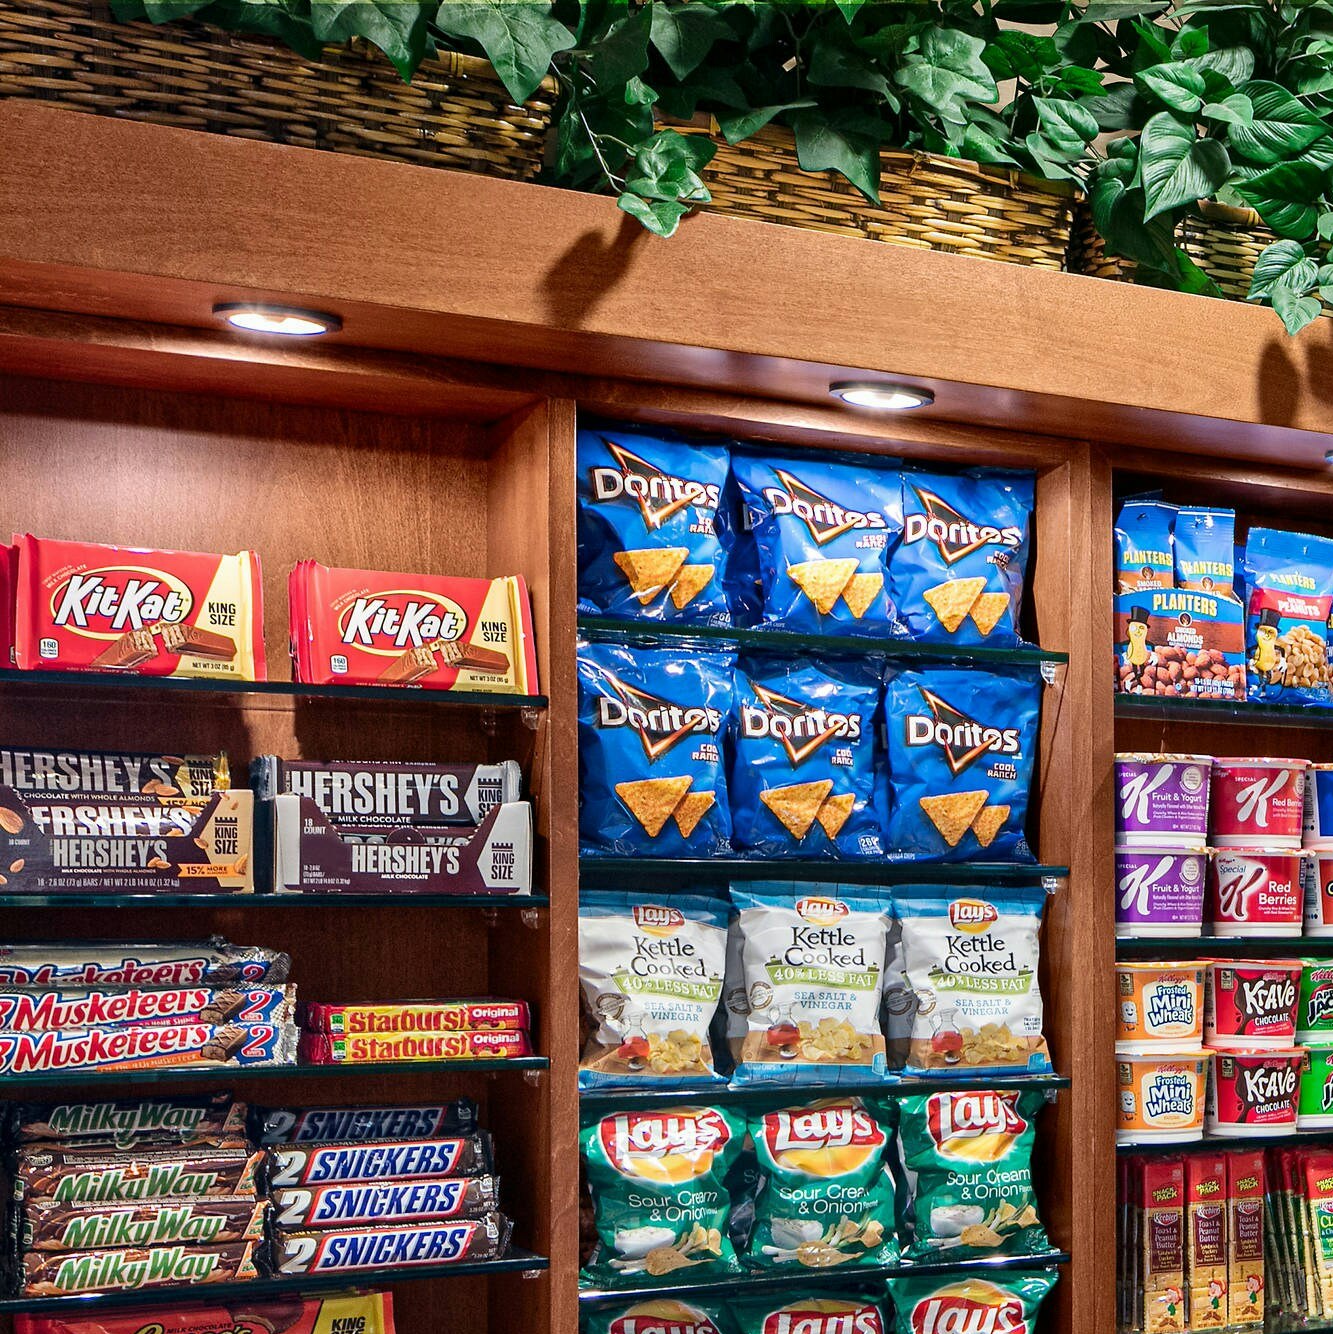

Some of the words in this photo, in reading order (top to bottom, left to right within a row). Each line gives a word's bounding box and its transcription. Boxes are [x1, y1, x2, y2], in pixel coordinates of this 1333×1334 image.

[763, 488, 886, 528] Doritos
[905, 514, 1021, 545] Doritos
[1181, 560, 1233, 577] PLANTERS
[208, 602, 236, 614] KING
[1153, 593, 1218, 618] PLANTERS
[209, 613, 236, 626] SIZE
[1167, 632, 1204, 645] ALMONDS
[600, 697, 721, 732] Doritos
[906, 715, 1020, 753] Doritos
[987, 770, 1016, 779] RANCH
[994, 763, 1015, 771] COOL
[24, 792, 69, 800] CHOCOLATE
[119, 795, 155, 803] ALMONDS
[292, 770, 458, 816] HERSHEY'S
[1152, 792, 1171, 801] Fruit
[1173, 793, 1179, 801] &
[1181, 793, 1202, 804] Yogurt
[304, 818, 313, 827] 18
[360, 816, 411, 824] CHOCOLATE
[214, 825, 238, 839] KING
[304, 826, 326, 835] COUNT
[53, 839, 168, 868] HERSHEY'S
[214, 839, 238, 855] SIZE
[352, 845, 460, 874] HERSHEY'S
[1268, 881, 1291, 893] Red
[1258, 893, 1297, 905] Berries
[791, 927, 855, 949] Kettle
[633, 935, 695, 959] Kettle
[785, 947, 865, 967] Cooked
[631, 956, 706, 979] Cooked
[774, 968, 807, 981] 40%
[808, 970, 845, 982] LESS
[849, 974, 873, 987] FAT
[794, 992, 815, 1000] SEA
[818, 992, 846, 1001] SALT
[850, 993, 857, 1001] &
[1157, 985, 1188, 996] Frosted
[15, 988, 211, 1030] Musketeers
[800, 1001, 852, 1010] VINEGAR
[1151, 993, 1192, 1010] Mini
[350, 1005, 466, 1032] Starburst
[472, 1008, 518, 1018] Original
[1148, 1007, 1193, 1027] Wheats
[15, 1025, 211, 1073] Musketeers
[272, 1151, 306, 1185] 2
[313, 1141, 454, 1181] SNICKERS
[946, 1172, 982, 1186] Sour
[986, 1168, 1030, 1183] Cream
[962, 1188, 971, 1200] &
[975, 1184, 1019, 1199] Onion
[281, 1238, 316, 1273] 2
[325, 1228, 466, 1270] SNICKERS
